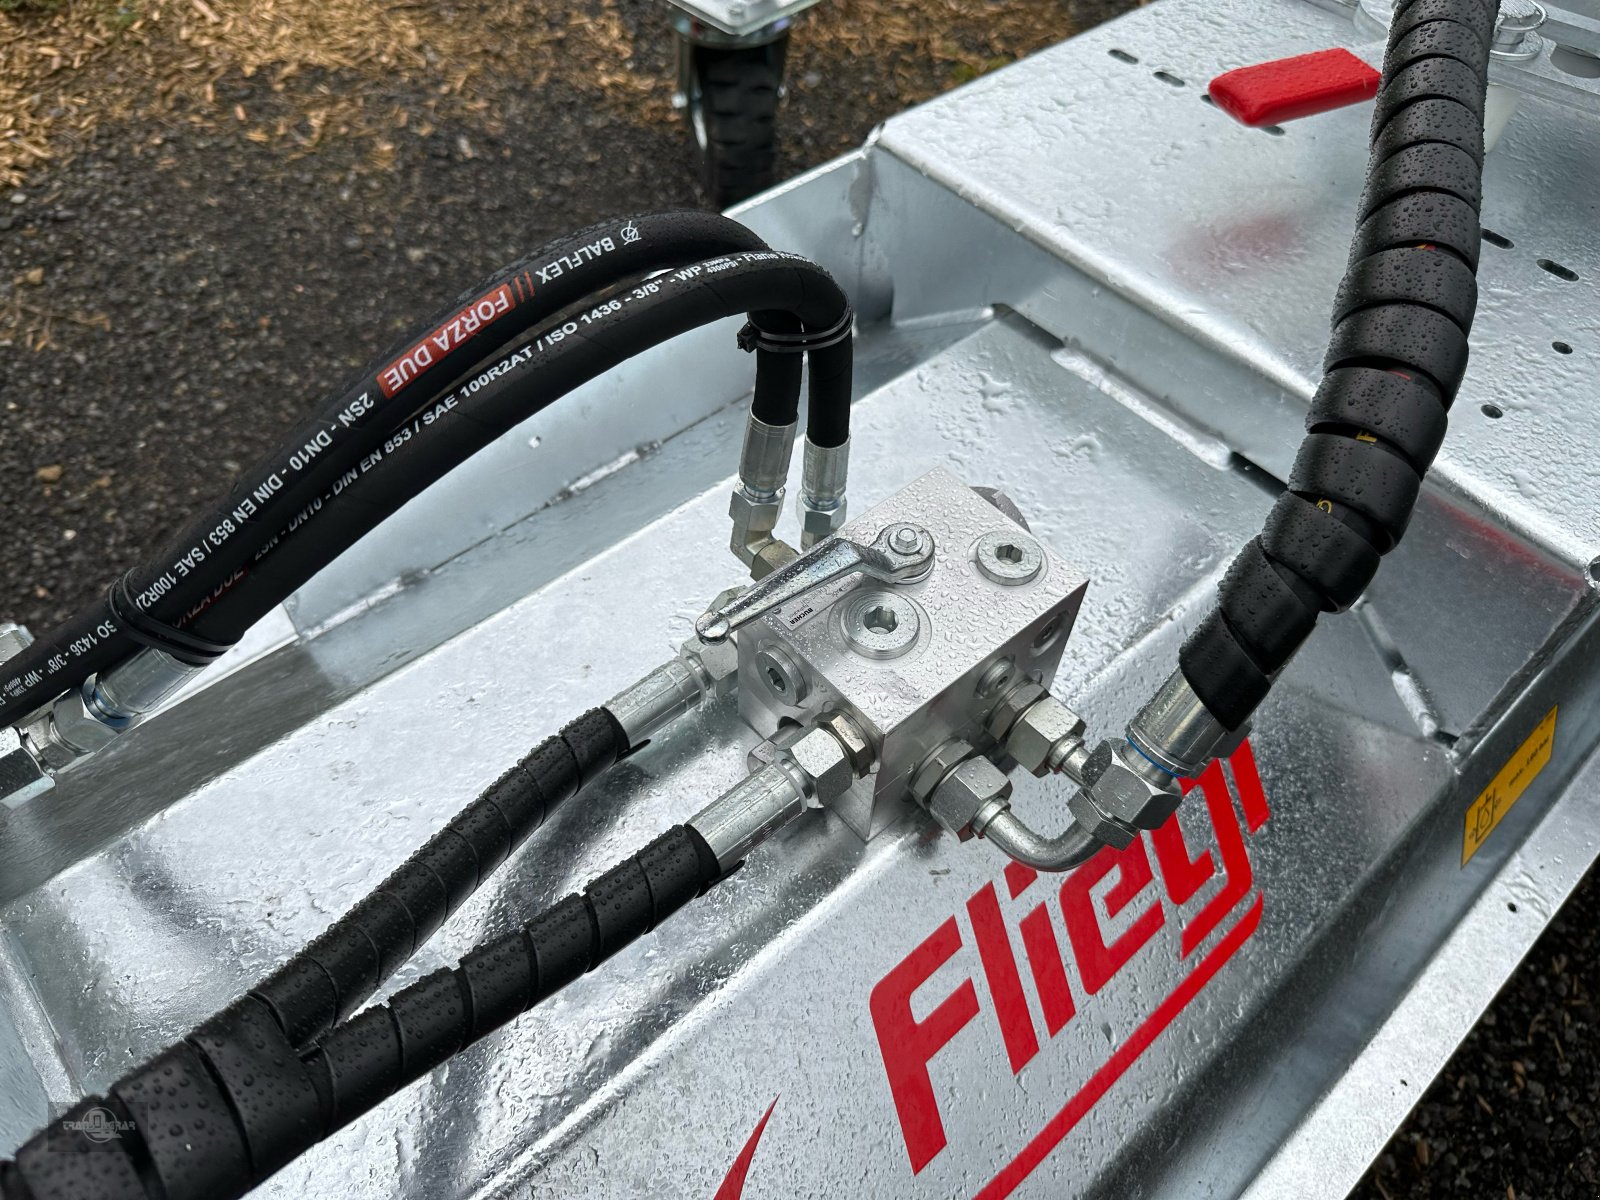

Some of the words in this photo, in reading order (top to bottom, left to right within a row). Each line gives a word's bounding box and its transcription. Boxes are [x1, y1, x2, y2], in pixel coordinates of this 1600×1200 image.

[535, 237, 615, 284] BALFLEX
[435, 291, 510, 351] FORZA
[384, 346, 432, 391] DUE
[288, 497, 323, 533] DN10
[332, 470, 359, 496] DIN
[360, 448, 383, 473] EN
[384, 427, 412, 454] 853
[423, 394, 459, 425] SAE
[460, 346, 534, 398] 100R2AT
[545, 322, 578, 346] ISO
[580, 300, 622, 324] 1436
[632, 279, 663, 299] 3/8"
[675, 265, 703, 282] WP
[338, 393, 374, 428] 2SN
[289, 430, 332, 471] DN10
[253, 473, 284, 504] DIN
[232, 499, 257, 525] EN
[209, 519, 236, 546] 853
[174, 547, 205, 577] SAE
[136, 572, 177, 611] 100R2
[97, 620, 118, 639] SO
[789, 607, 814, 625] BUCHER
[70, 632, 97, 657] 1436
[22, 670, 43, 688] WP
